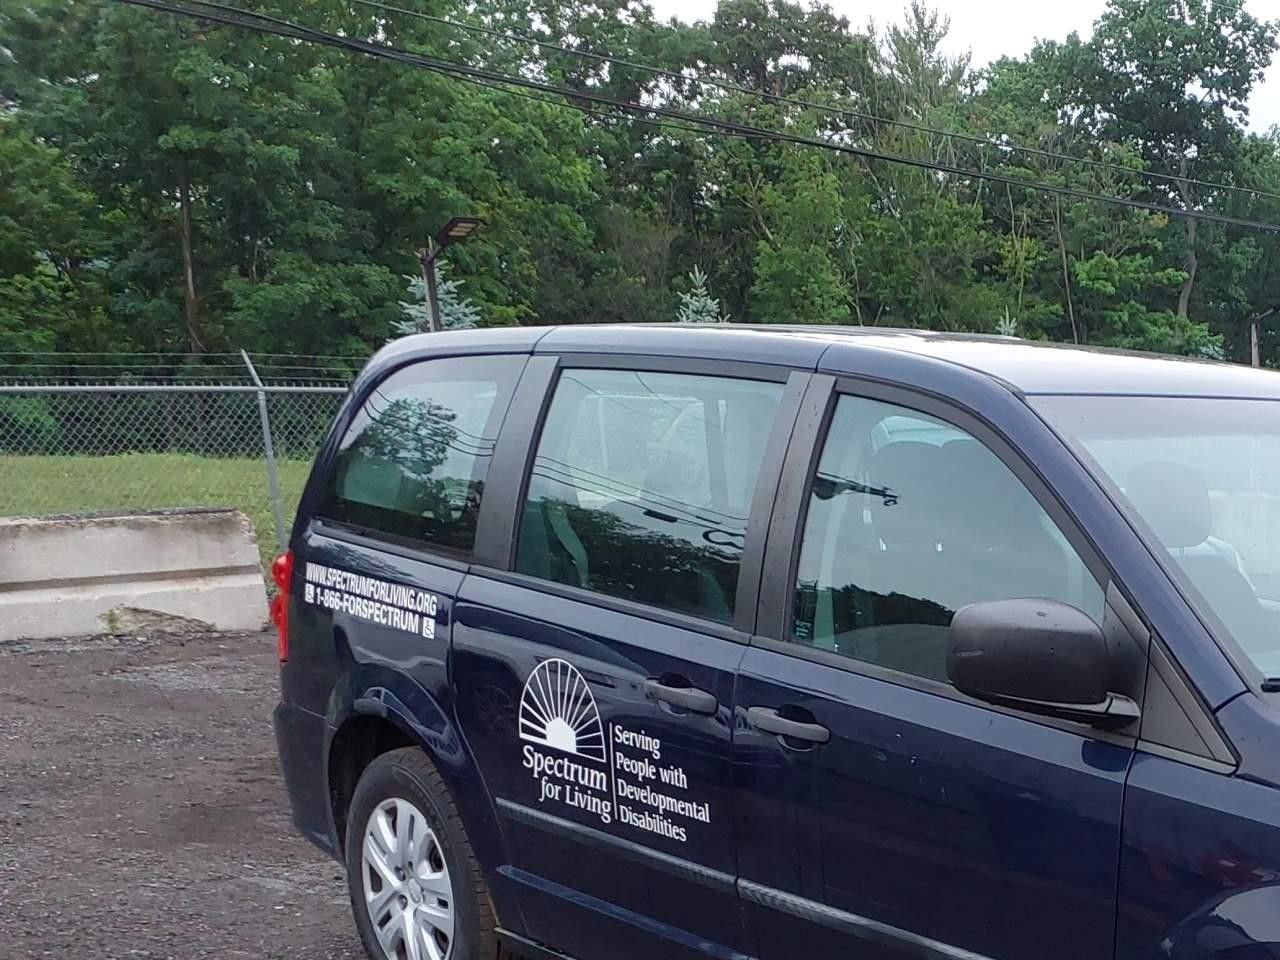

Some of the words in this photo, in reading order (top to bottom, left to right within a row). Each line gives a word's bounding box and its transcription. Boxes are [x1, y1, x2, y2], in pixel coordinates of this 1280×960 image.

[306, 562, 437, 616] WWW.SPECTRUMFORLIVING.ORG
[316, 587, 419, 634] 1-866-FORSPECTRUM
[614, 724, 661, 760] Serving
[522, 744, 608, 793] Spectrum
[616, 751, 657, 782] People
[659, 764, 688, 790] with
[539, 776, 562, 802] for
[565, 785, 612, 824] Living
[617, 777, 711, 823] Developmental
[619, 804, 687, 842] Disabilities
